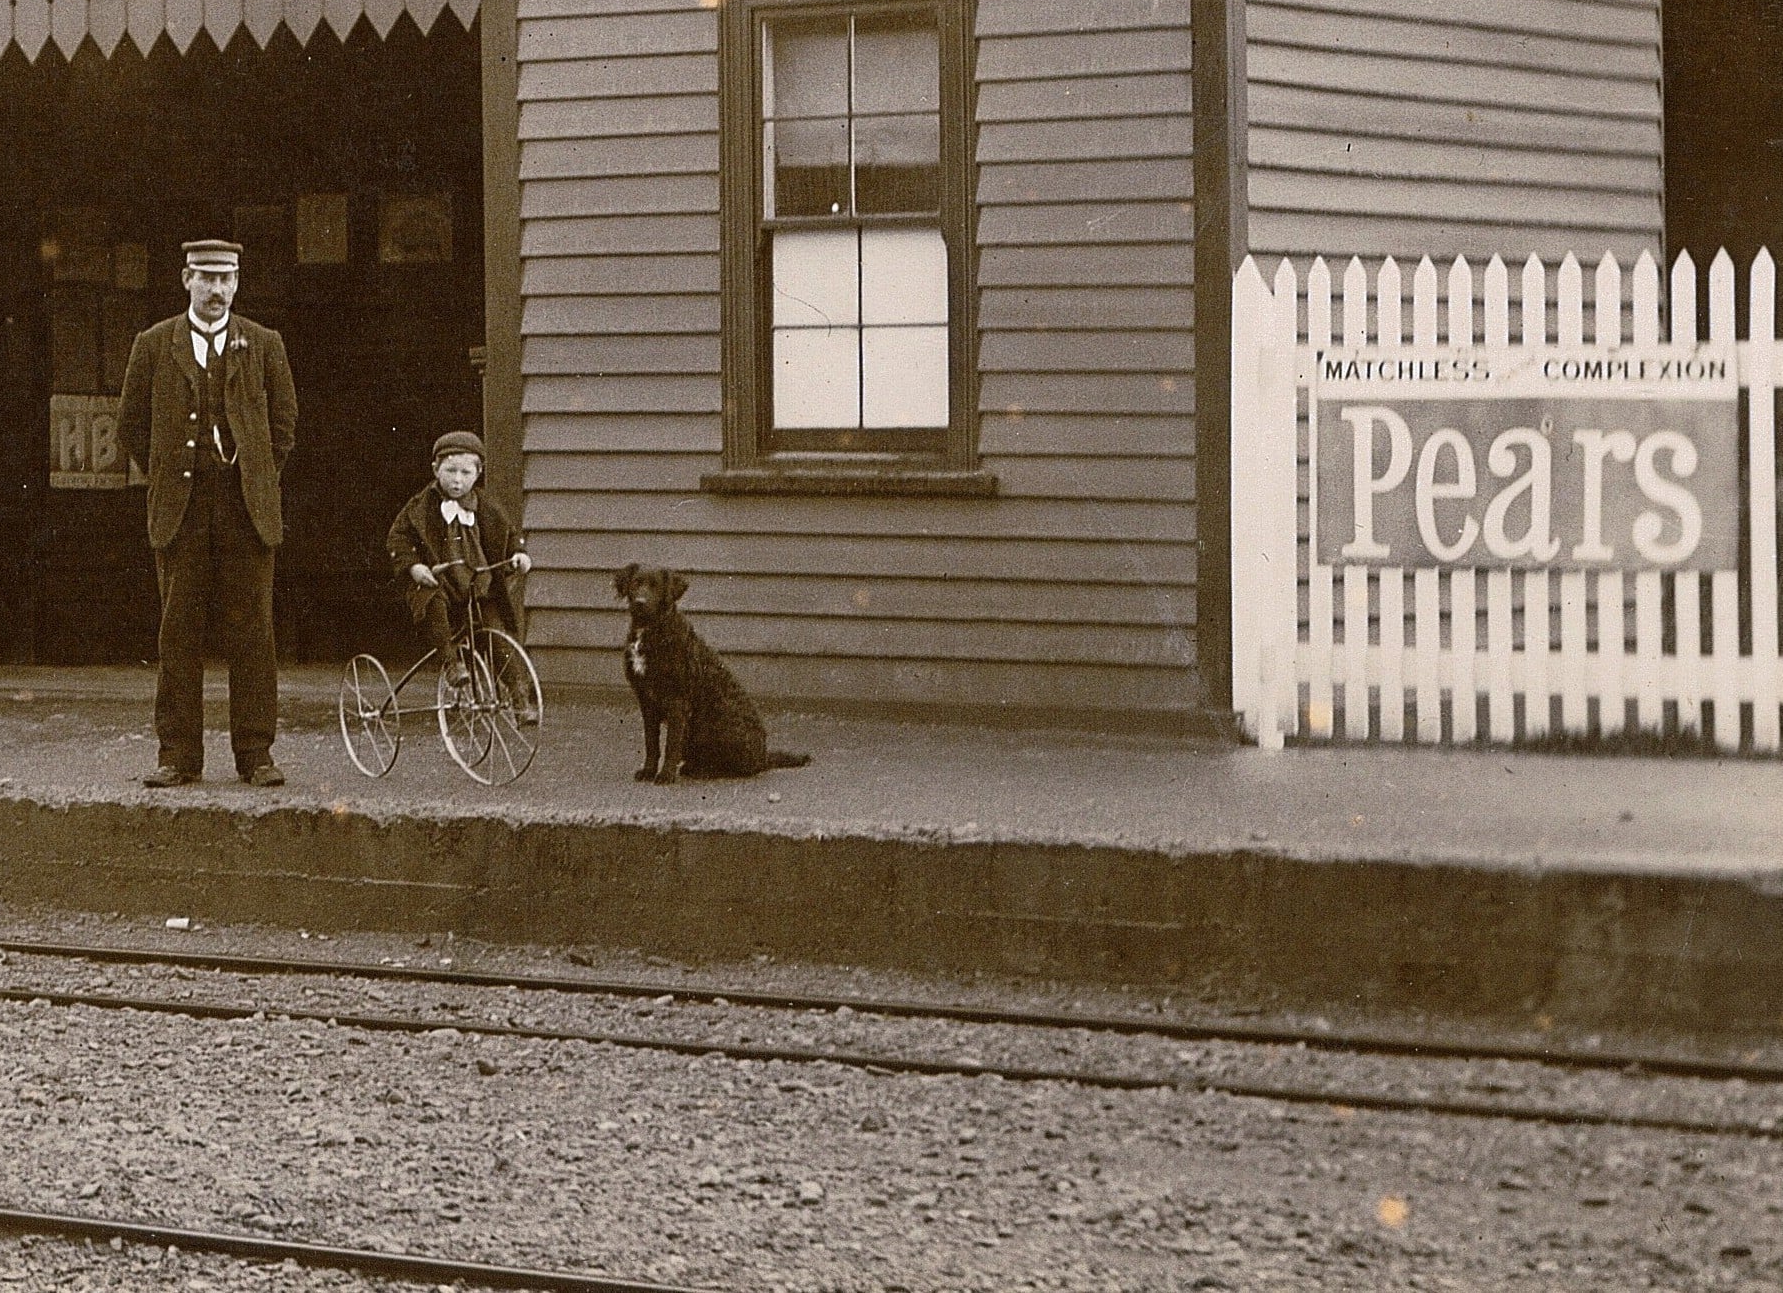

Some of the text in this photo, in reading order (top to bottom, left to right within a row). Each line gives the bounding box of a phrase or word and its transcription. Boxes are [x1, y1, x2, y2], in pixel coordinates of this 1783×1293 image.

[1325, 359, 1726, 382] MATCHLESS COMPLEXION
[1341, 406, 1703, 565] Pears
